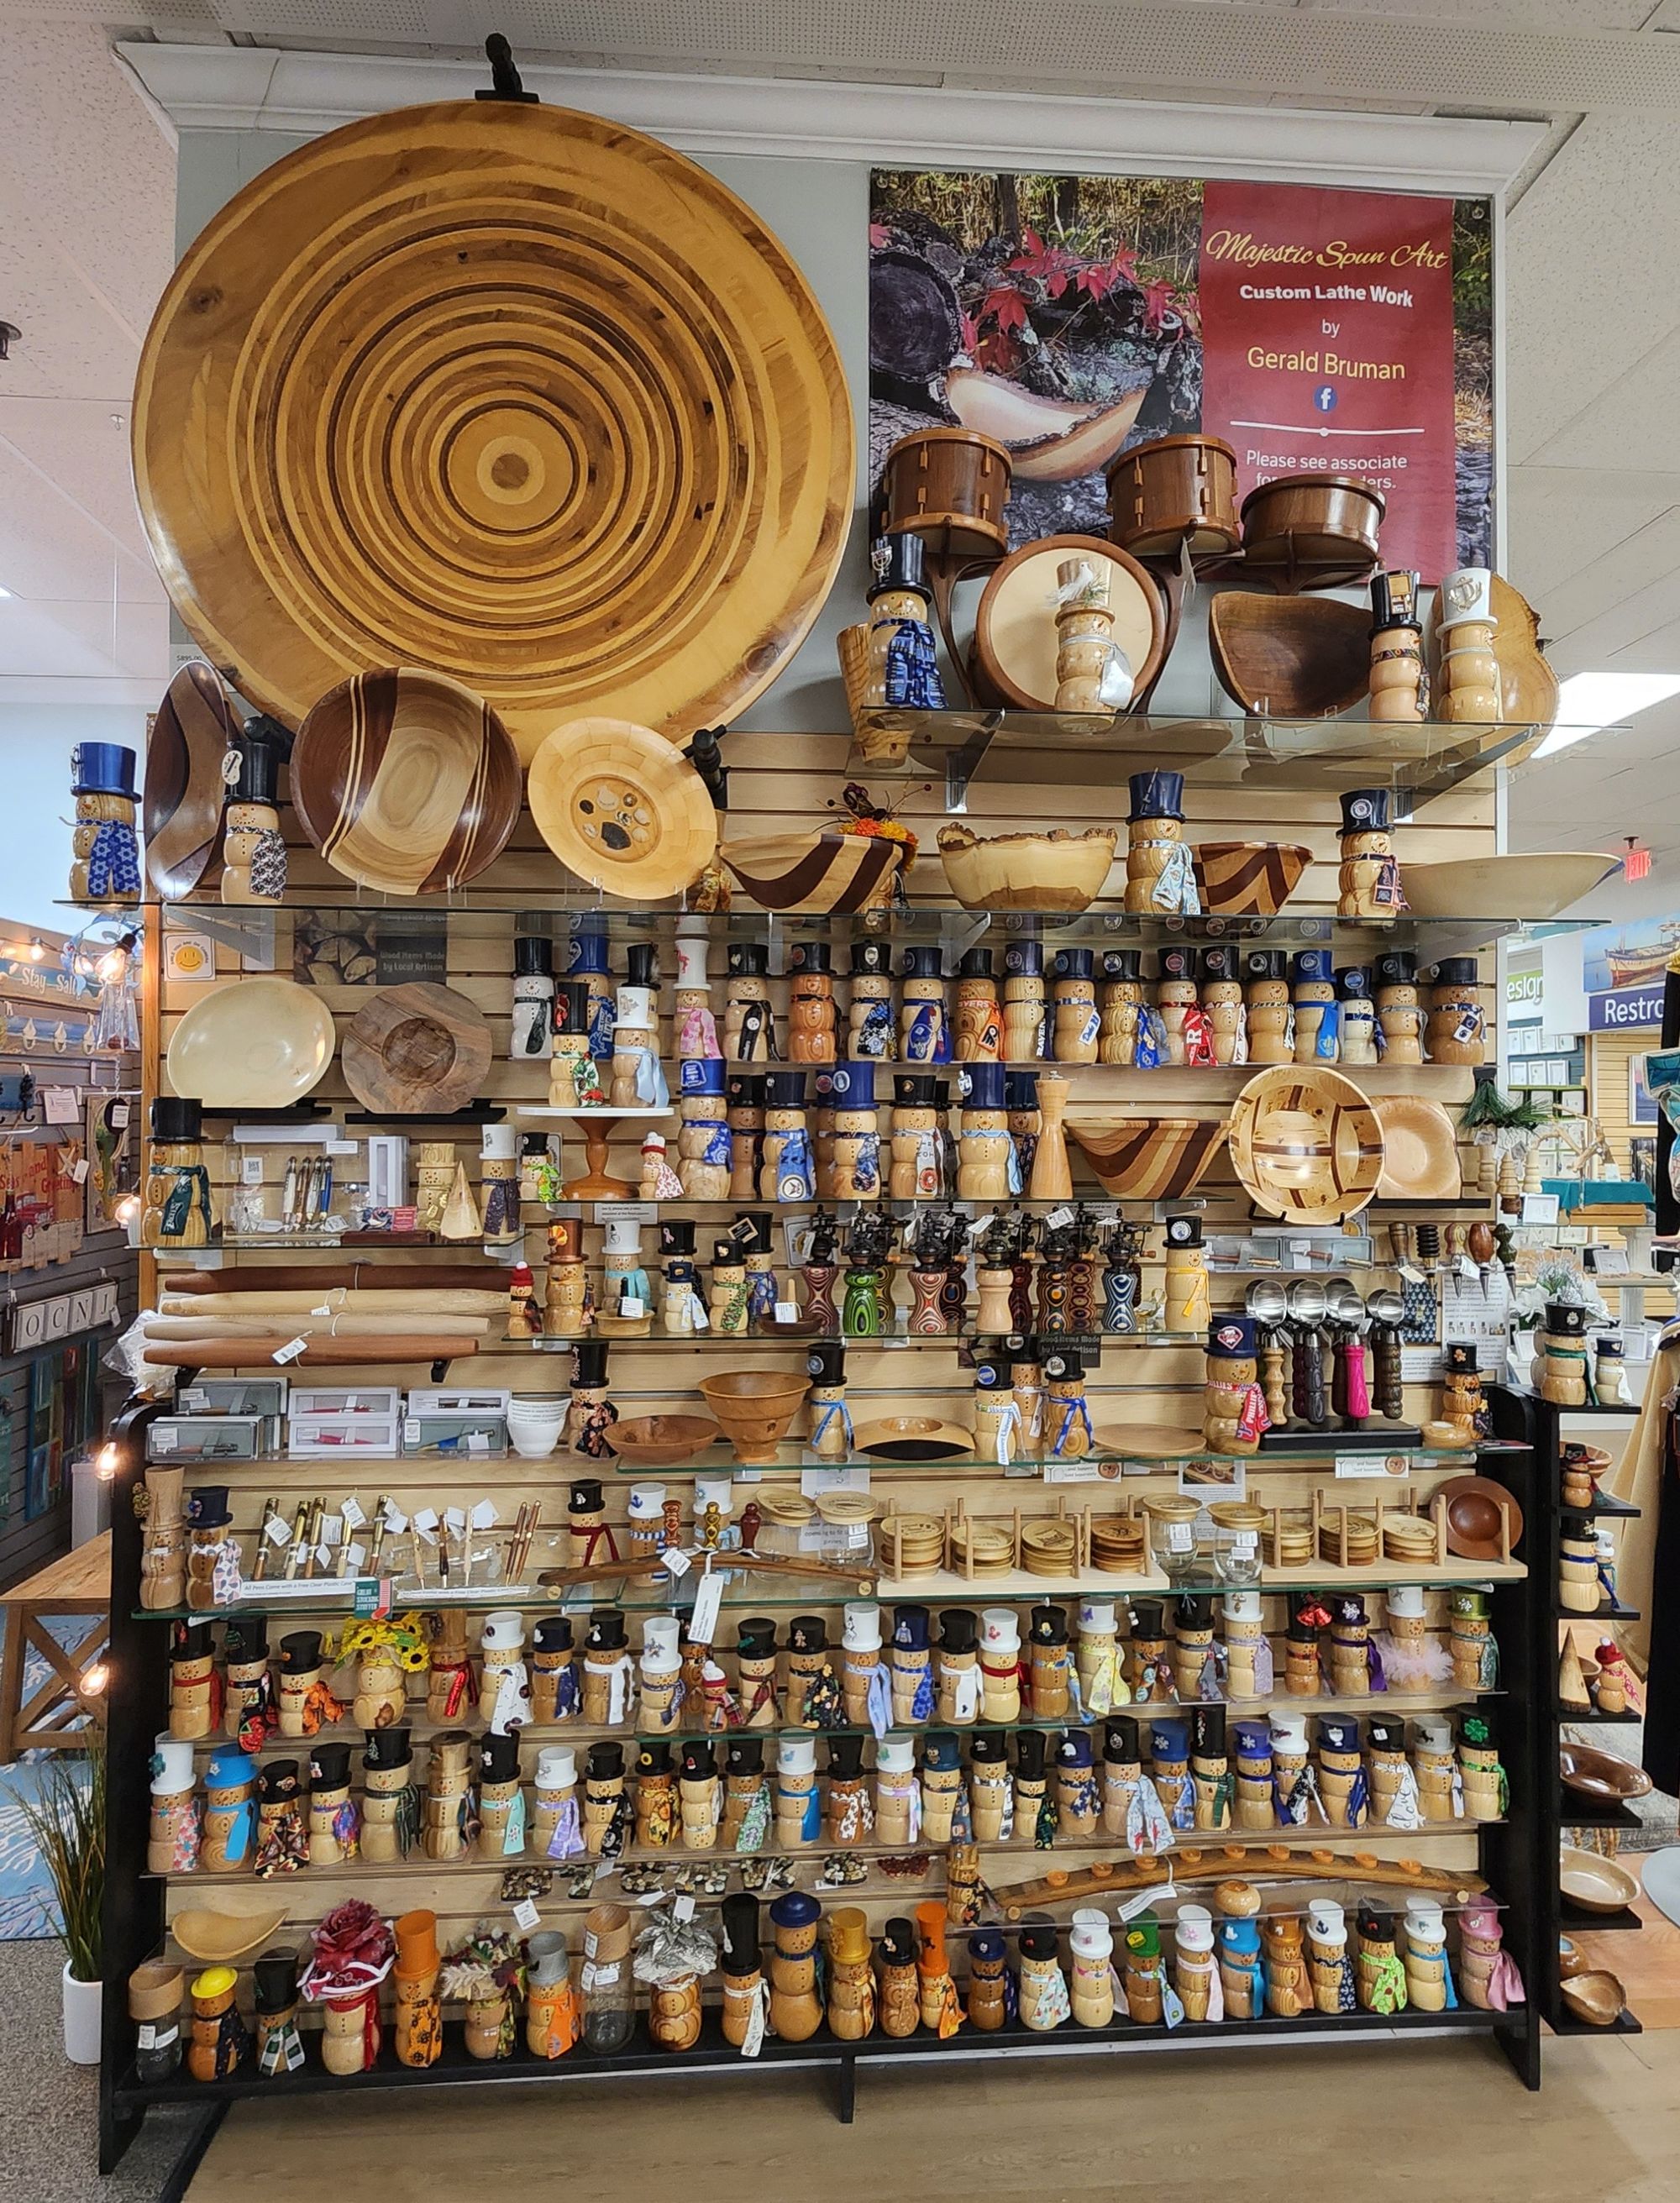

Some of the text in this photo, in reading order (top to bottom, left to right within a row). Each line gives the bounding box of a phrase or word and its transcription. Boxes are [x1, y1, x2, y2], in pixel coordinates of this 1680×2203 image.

[1205, 230, 1448, 270] Majestic Spun Art
[1240, 285, 1413, 307] Custom Lathe Work
[1321, 318, 1340, 338] by
[1247, 347, 1406, 380] Gerald Bruman
[1247, 449, 1408, 470] Please see associate
[22, 967, 47, 994] Stay
[1036, 1018, 1047, 1057] RAVEN
[1245, 1390, 1258, 1424] PHILLIE
